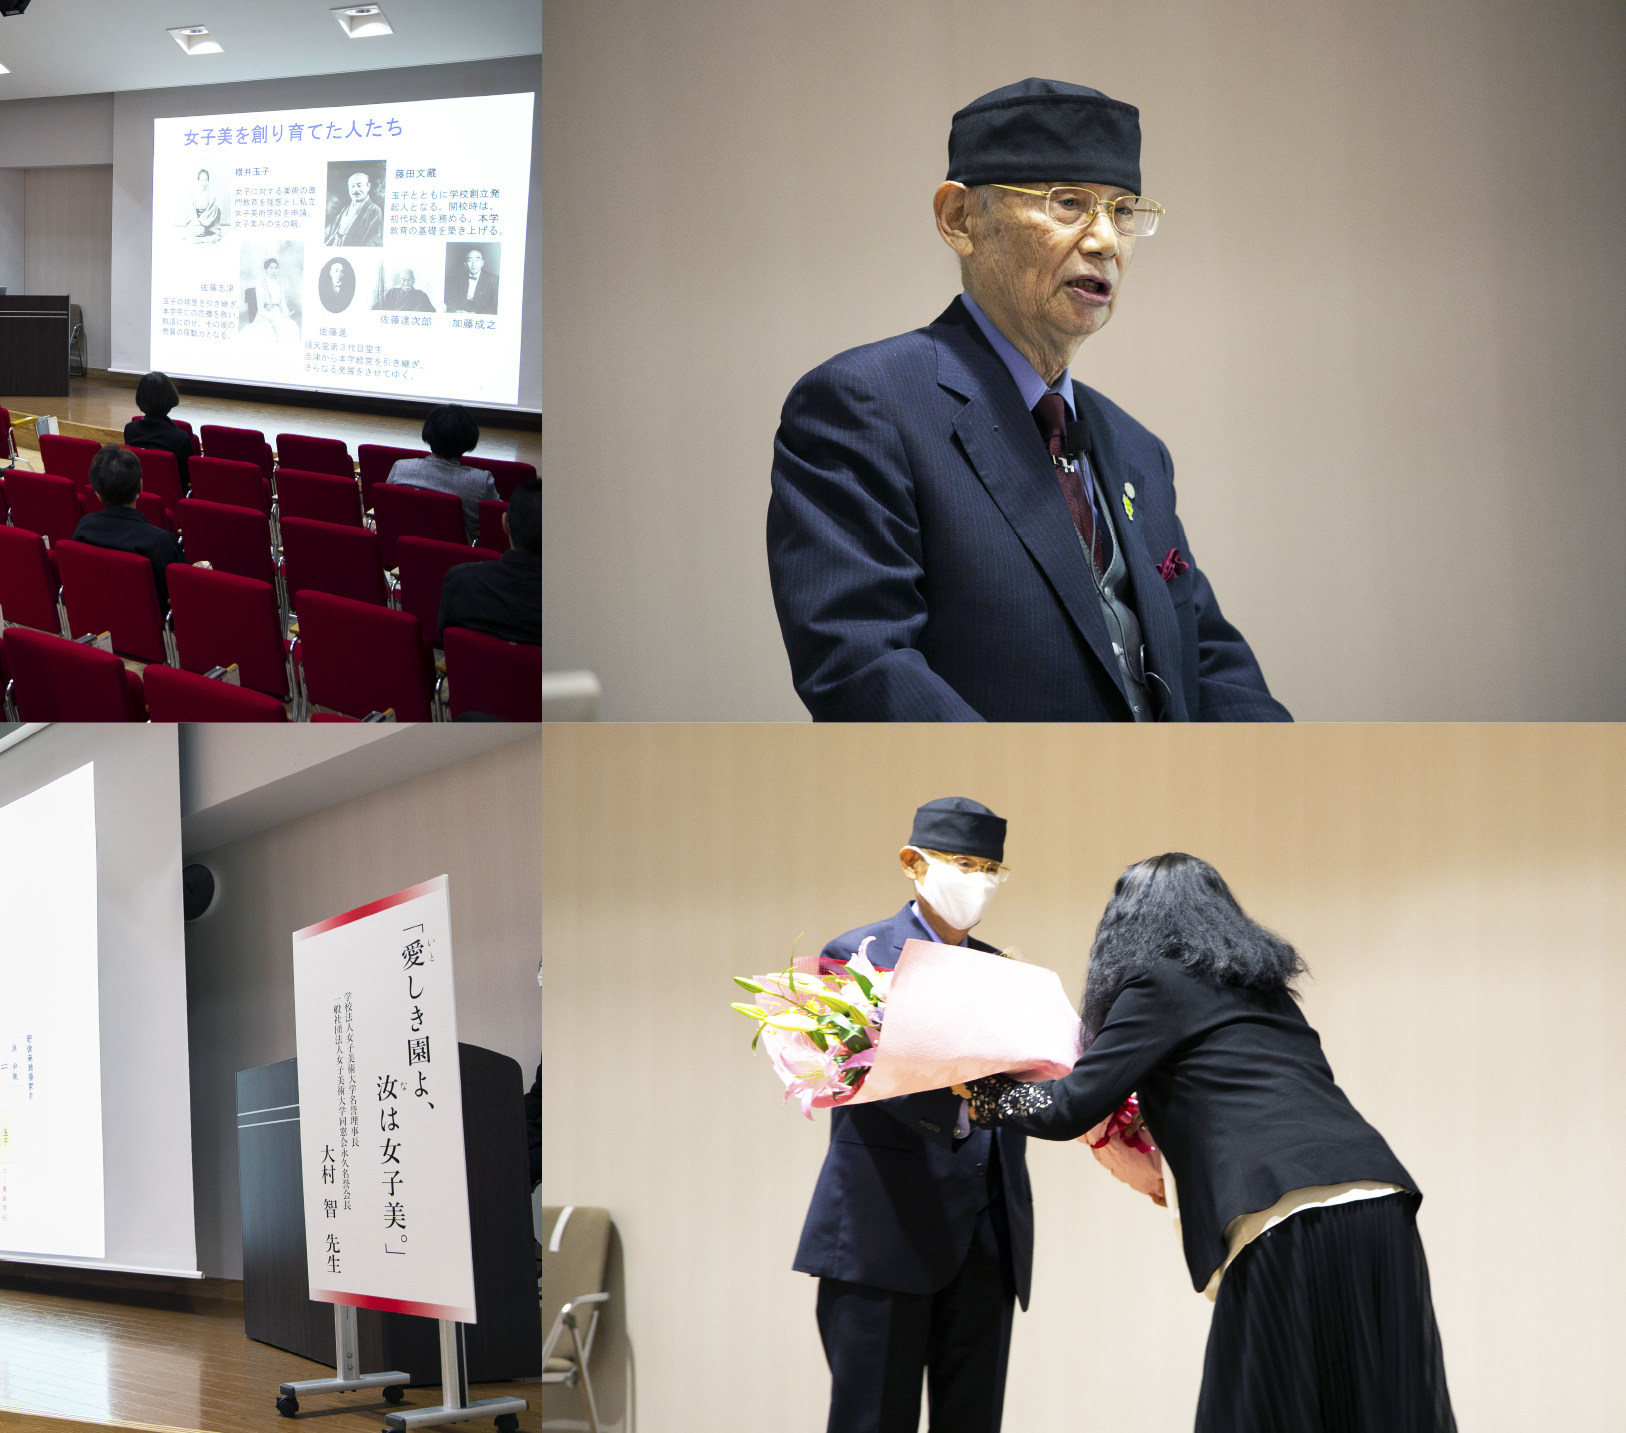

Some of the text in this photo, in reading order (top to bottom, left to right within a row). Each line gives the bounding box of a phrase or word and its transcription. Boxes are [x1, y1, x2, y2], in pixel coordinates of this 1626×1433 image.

[184, 117, 402, 146] 女子美を創り育てた人たち
[235, 167, 270, 177] 横井玉子
[391, 189, 500, 200] 玉子とともに学校創立発
[390, 213, 499, 224] 初代校長を務める。本学
[390, 225, 503, 236] 教育の基礎を築き上げる。
[452, 318, 496, 330] 加藤成之
[401, 923, 435, 1110] 「愛しき園よ、
[344, 991, 359, 1148] 学校法人女子美術大学名誉理事長
[333, 997, 352, 1211] 一般社団法人女子美術大学同窓会永久名誉会長
[376, 1074, 408, 1255] 汝は女子美。」
[321, 1144, 342, 1274] 大村 智 先生
